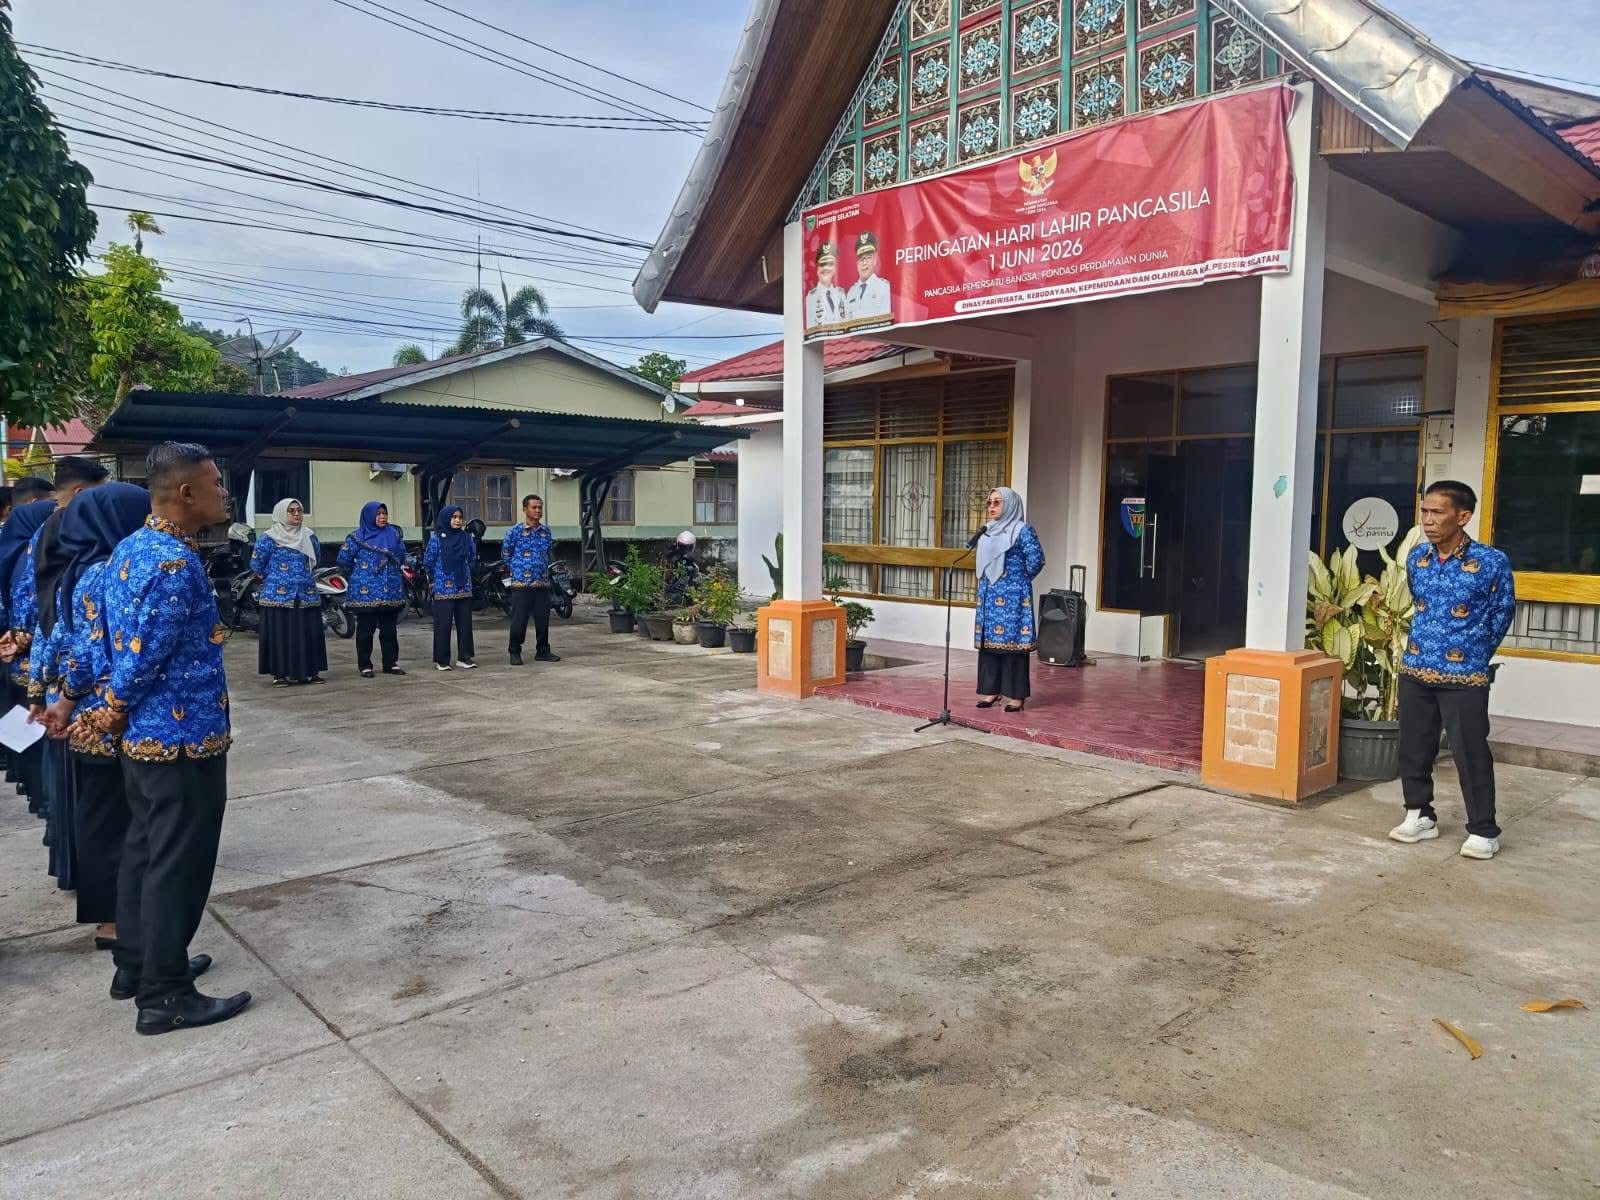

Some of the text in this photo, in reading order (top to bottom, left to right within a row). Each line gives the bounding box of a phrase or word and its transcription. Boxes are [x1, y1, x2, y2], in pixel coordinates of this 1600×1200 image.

[895, 186, 1211, 265] PERINGATAN HARI LAHIR PANCASILA
[924, 282, 961, 298] PANCASILA
[962, 278, 1004, 292] PEMERSATU
[1041, 265, 1078, 280] FONDASI
[1080, 255, 1137, 272] PERDAMAIAN
[1139, 250, 1169, 263] DUNIA
[989, 237, 1083, 271] 1 JUNI 2026
[961, 301, 981, 310] DINAS
[981, 295, 1025, 307] PARIWISATA,
[1026, 286, 1078, 300] KEBUDAYAAN,
[1078, 278, 1132, 292] KEPEMUDAAN
[1132, 274, 1150, 284] DAN
[1151, 267, 1199, 281] OLAHRAGA
[1212, 259, 1246, 271] PESISIR
